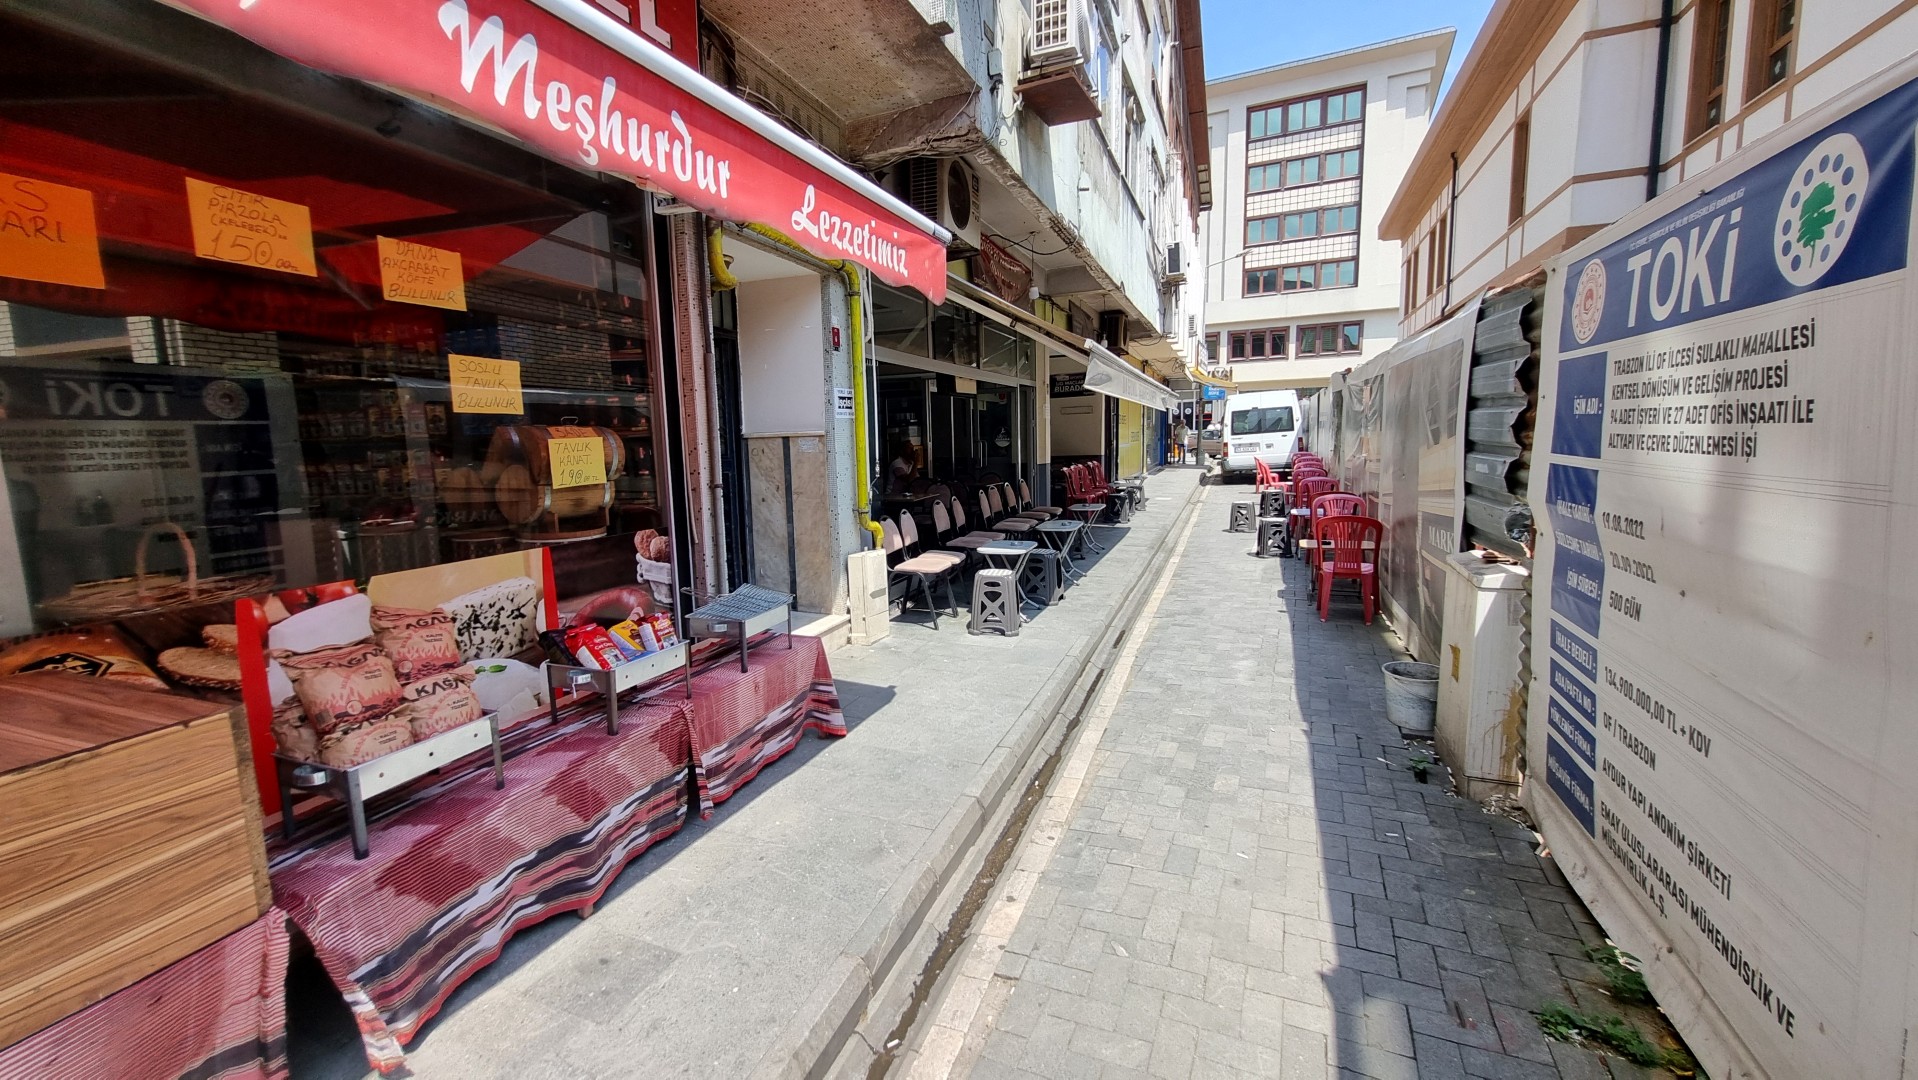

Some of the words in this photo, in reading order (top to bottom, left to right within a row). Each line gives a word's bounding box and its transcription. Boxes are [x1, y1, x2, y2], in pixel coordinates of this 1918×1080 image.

[437, 0, 730, 199] Meşhurdur
[791, 184, 908, 278] Lezzetimiz
[1613, 355, 1644, 376] TRABZON
[1645, 351, 1656, 372] İLİ
[1656, 348, 1667, 369] OF
[1667, 342, 1695, 372] İLÇESİ
[1696, 338, 1740, 363] SULAKLI
[1741, 318, 1815, 356] MAHALLESİ
[457, 359, 502, 375] SOSLU
[460, 377, 509, 392] TAVUK
[1611, 382, 1640, 400] KENTSEL
[1641, 374, 1680, 401] DÖNÜŞÜM
[1682, 374, 1693, 394] VE
[1694, 369, 1734, 398] GELİŞİM
[1734, 359, 1789, 390] PROJESİ
[458, 393, 518, 412] BULUNUR
[1610, 409, 1618, 425] 94
[1618, 407, 1636, 425] ADET
[1636, 404, 1660, 429] İŞYERİ
[1662, 406, 1672, 425] VE
[1674, 405, 1683, 424] 27
[1685, 404, 1709, 425] ADET
[1710, 401, 1733, 424] OFİS
[1735, 398, 1788, 430] İNŞAATI
[1791, 394, 1815, 423] İLE
[554, 441, 593, 454] TAVUK
[1608, 432, 1635, 449] ALTYAPI
[1635, 434, 1645, 450] VE
[1646, 434, 1671, 455] ÇEVRE
[1672, 430, 1738, 457] DÜZENLEMESİ
[1741, 432, 1757, 463] İŞİ
[1601, 512, 1645, 540] 19.08.2022
[1610, 551, 1656, 583] 20.09.2022
[1609, 591, 1623, 614] 500
[1624, 596, 1642, 622] GÜN
[1604, 666, 1665, 724] 134.900.000,00
[1667, 708, 1678, 735] TL
[1688, 725, 1712, 758] KDV
[1603, 712, 1613, 731] OF
[1618, 723, 1656, 771] TRABZON
[1602, 757, 1627, 794] AYDUR
[1628, 780, 1646, 814] YAPI
[1648, 802, 1685, 854] ANONİM
[1687, 840, 1732, 901] ŞİRKETİ
[1602, 825, 1648, 893] MÜŞAVİRLİK
[1601, 801, 1621, 834] EMAY
[1621, 823, 1688, 914] ULUSLARARASI
[1690, 899, 1773, 1015] MÜHENDİSLİK
[1776, 996, 1795, 1039] VE
